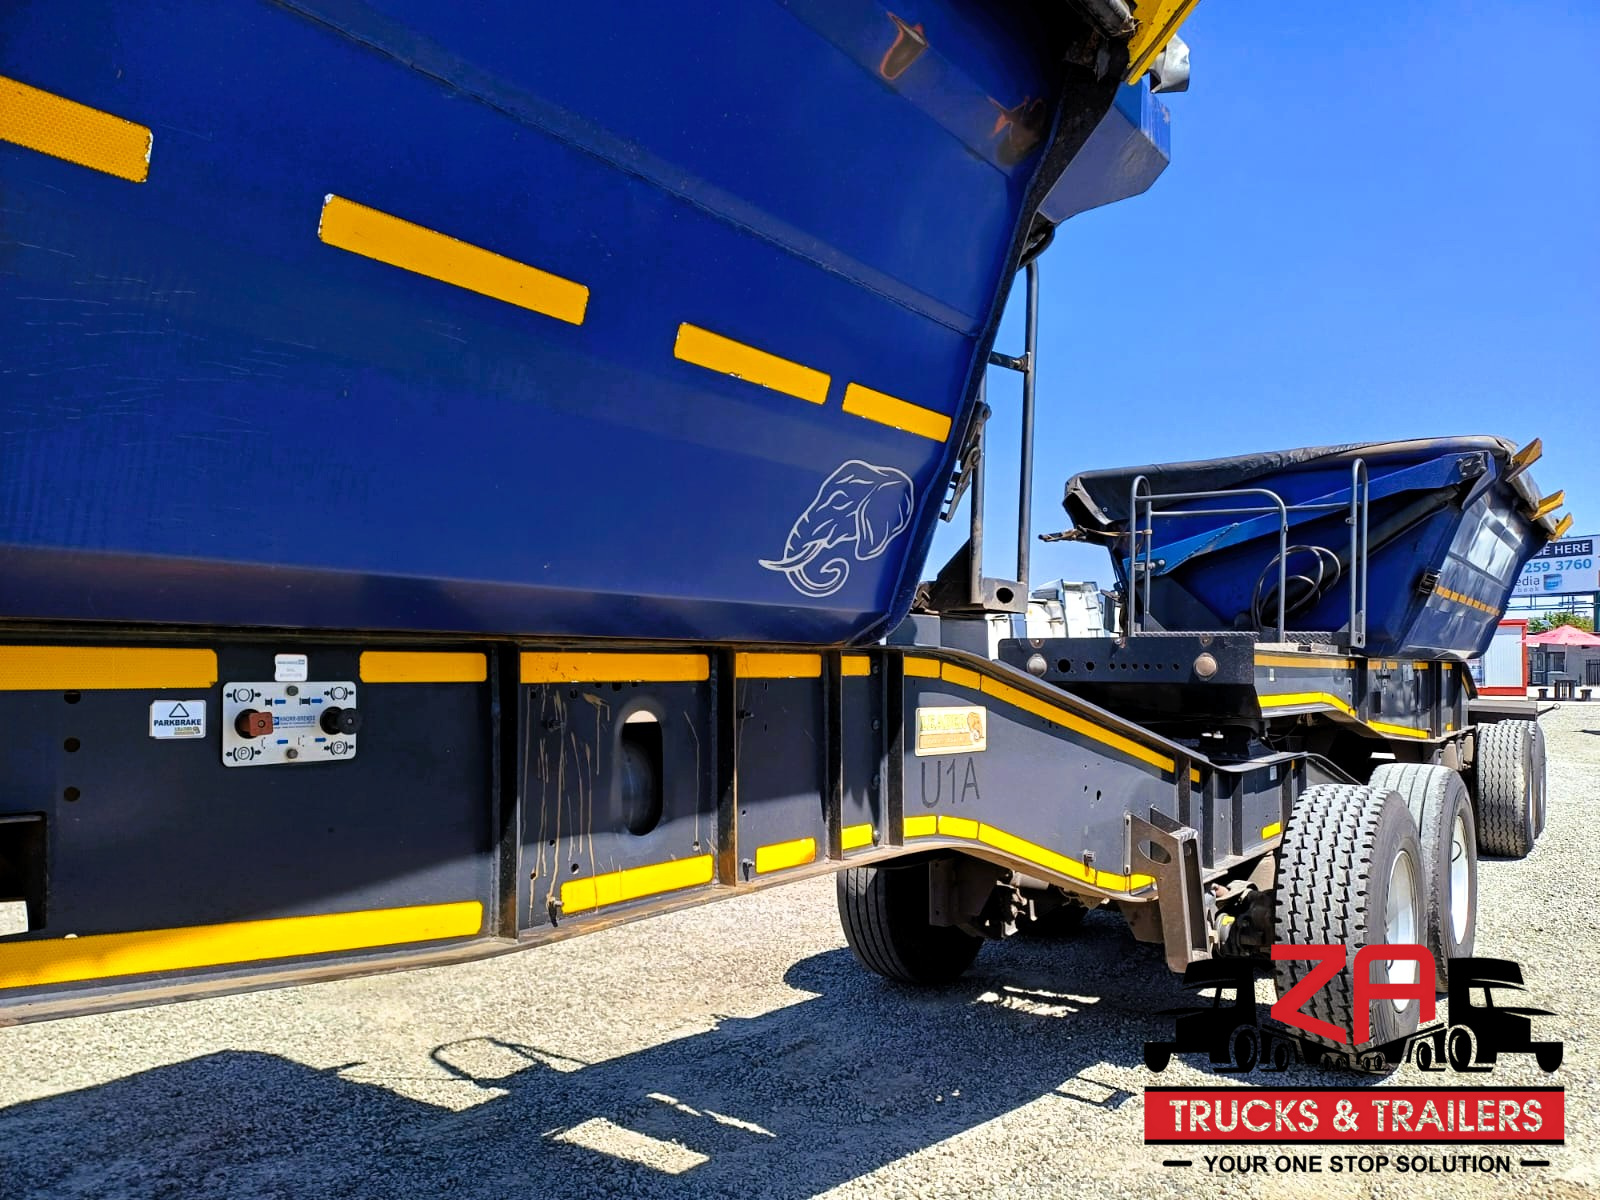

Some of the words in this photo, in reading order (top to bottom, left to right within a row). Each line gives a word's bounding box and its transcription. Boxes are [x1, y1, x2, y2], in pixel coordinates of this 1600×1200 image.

[1554, 542, 1590, 554] HERE
[1524, 561, 1550, 573] 259
[1555, 558, 1592, 571] 3760
[1516, 575, 1540, 586] edia
[153, 718, 202, 727] PARKBRAKE
[921, 756, 980, 809] U1A
